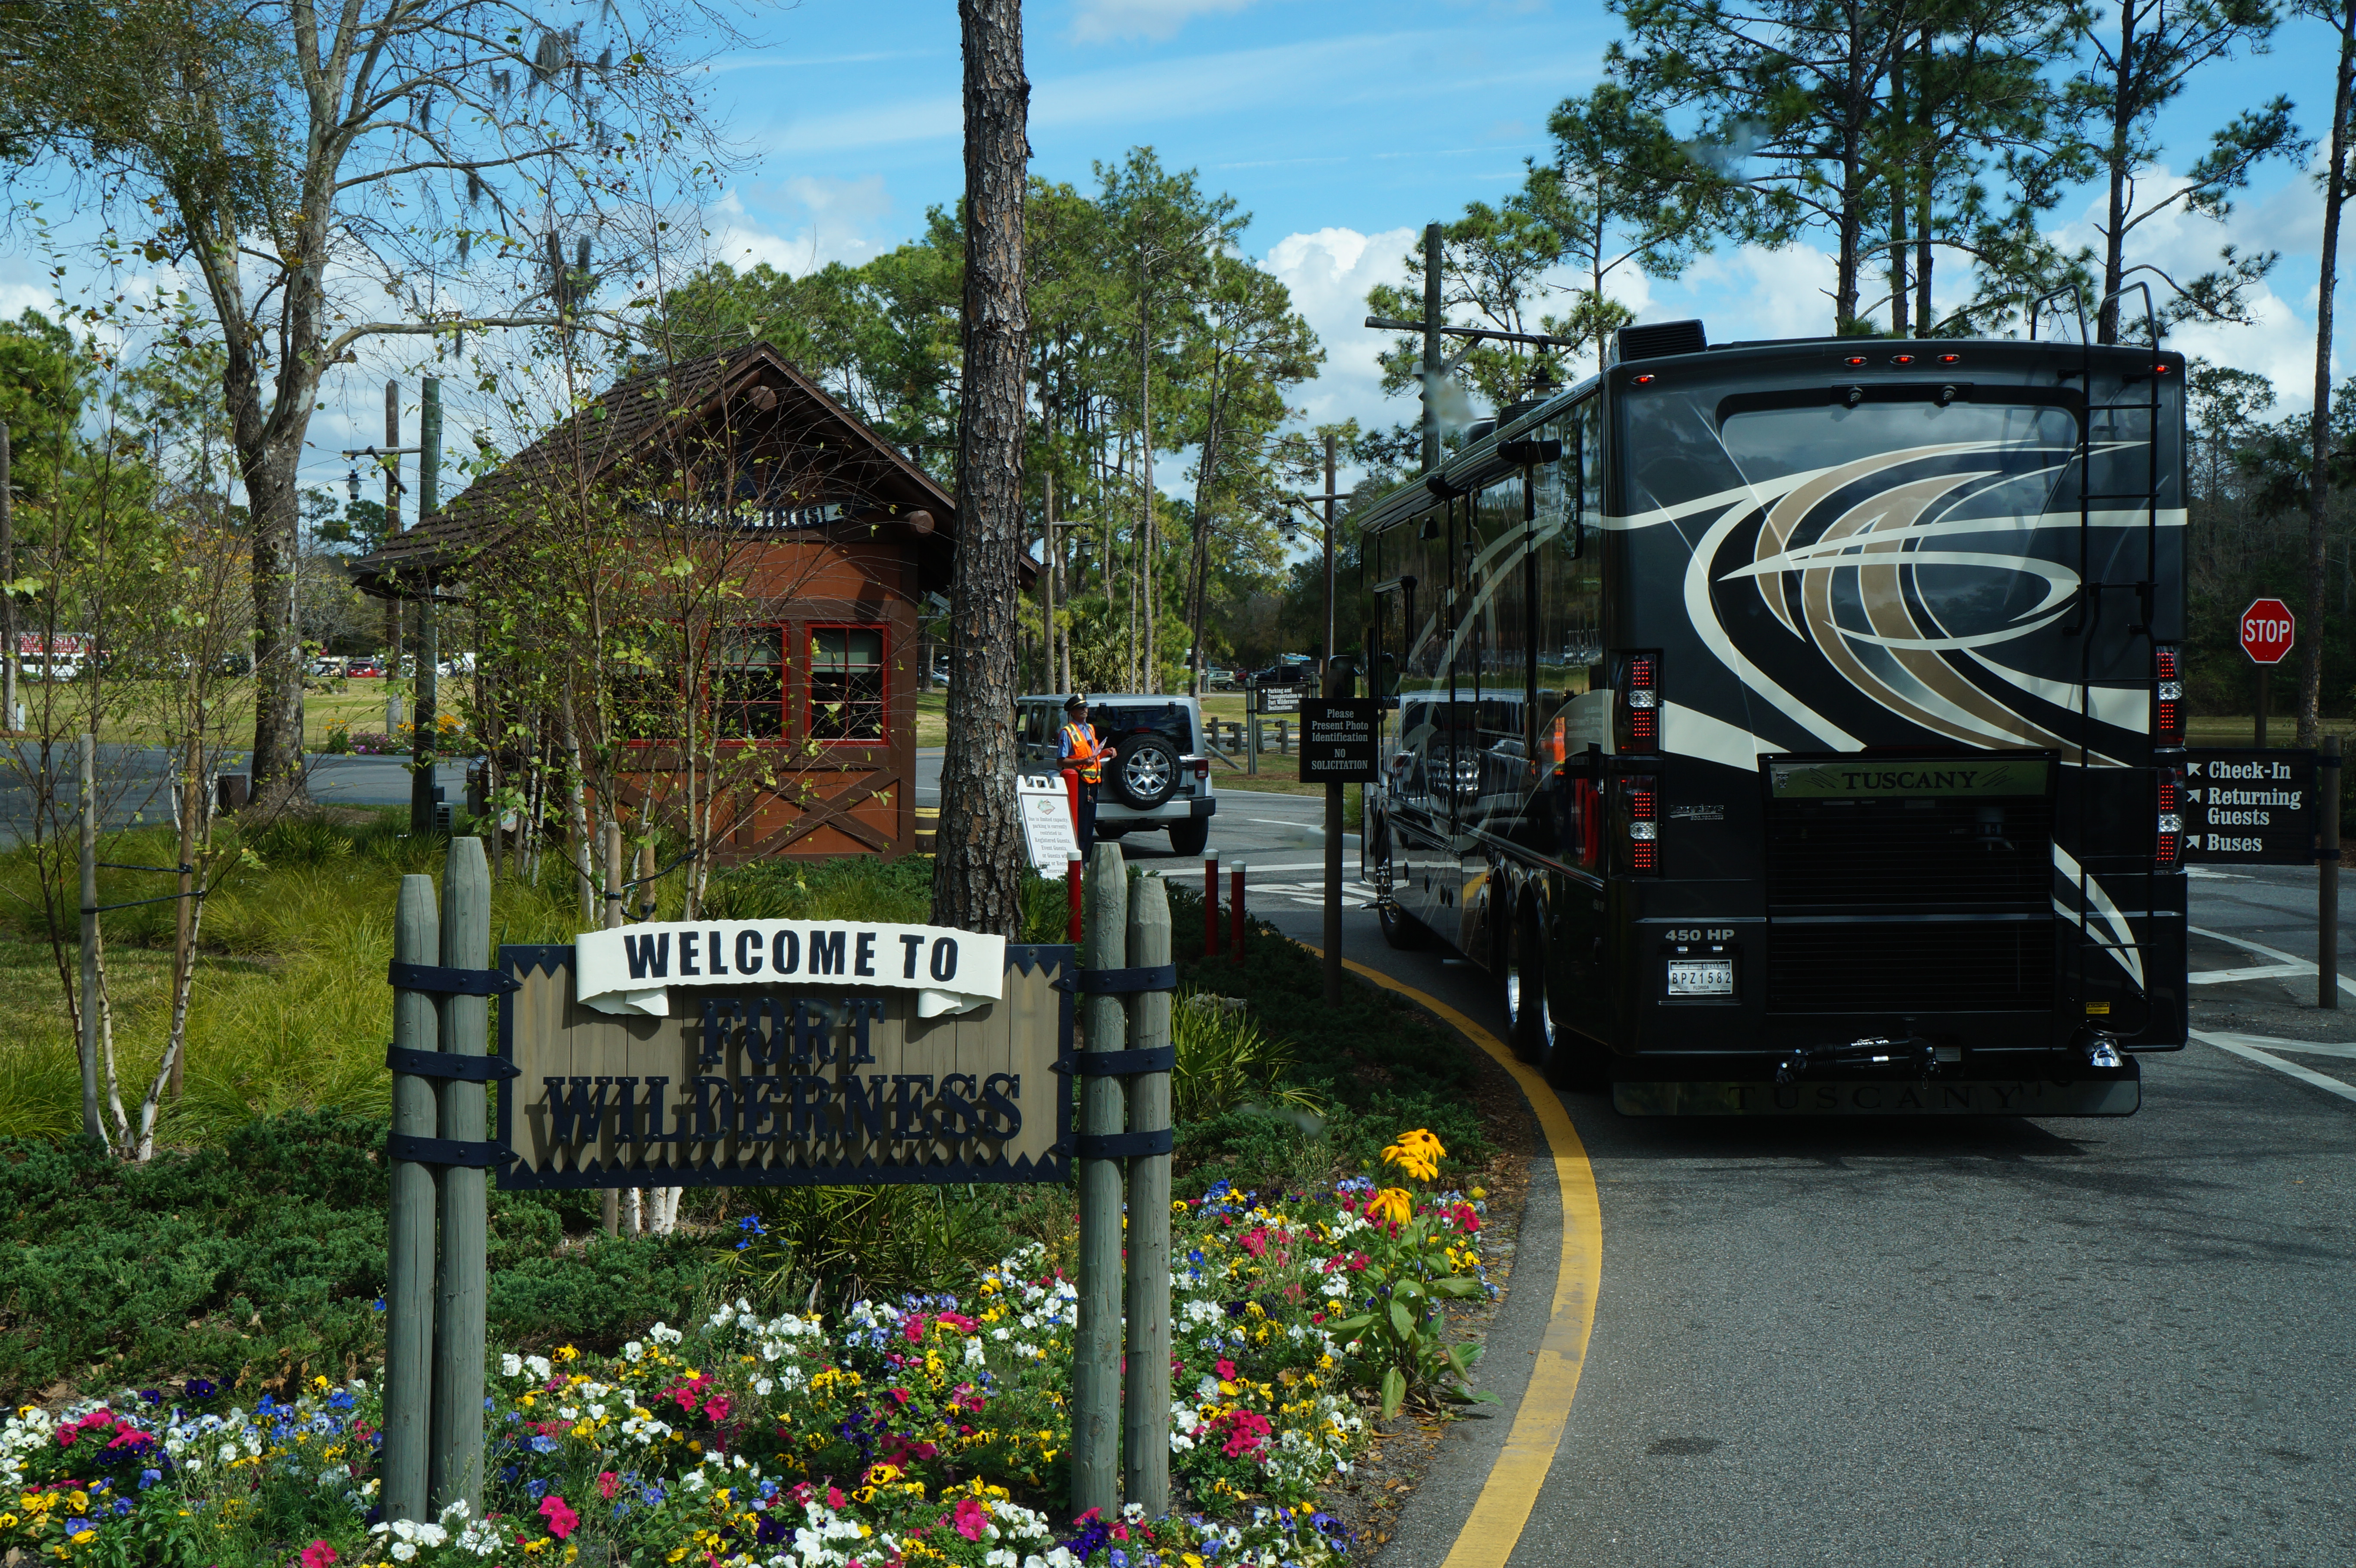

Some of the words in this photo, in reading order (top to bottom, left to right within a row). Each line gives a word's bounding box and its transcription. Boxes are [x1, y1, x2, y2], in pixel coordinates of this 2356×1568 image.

[2245, 619, 2290, 642] STOP
[1327, 709, 1354, 718] Please
[1312, 721, 1343, 730] Present
[1346, 721, 1368, 730] Photo
[1312, 733, 1368, 741] Identification
[1334, 749, 1346, 758] NO
[1312, 760, 1368, 769] SOLICITATION
[2209, 761, 2291, 779] Check-In
[1841, 771, 1978, 790] TUSCANY
[2208, 787, 2302, 810] Returning
[2207, 807, 2270, 825] Guests
[2207, 833, 2262, 852] Buses
[1665, 929, 1702, 941] 450
[1707, 929, 1735, 940] HP
[624, 929, 876, 979] WELCOME
[899, 934, 958, 982] TO
[1672, 972, 1731, 984] BPZ1582
[699, 998, 884, 1065] FORT
[1728, 1085, 2019, 1110] TUSCANY
[543, 1073, 1022, 1144] WILDERNESS
